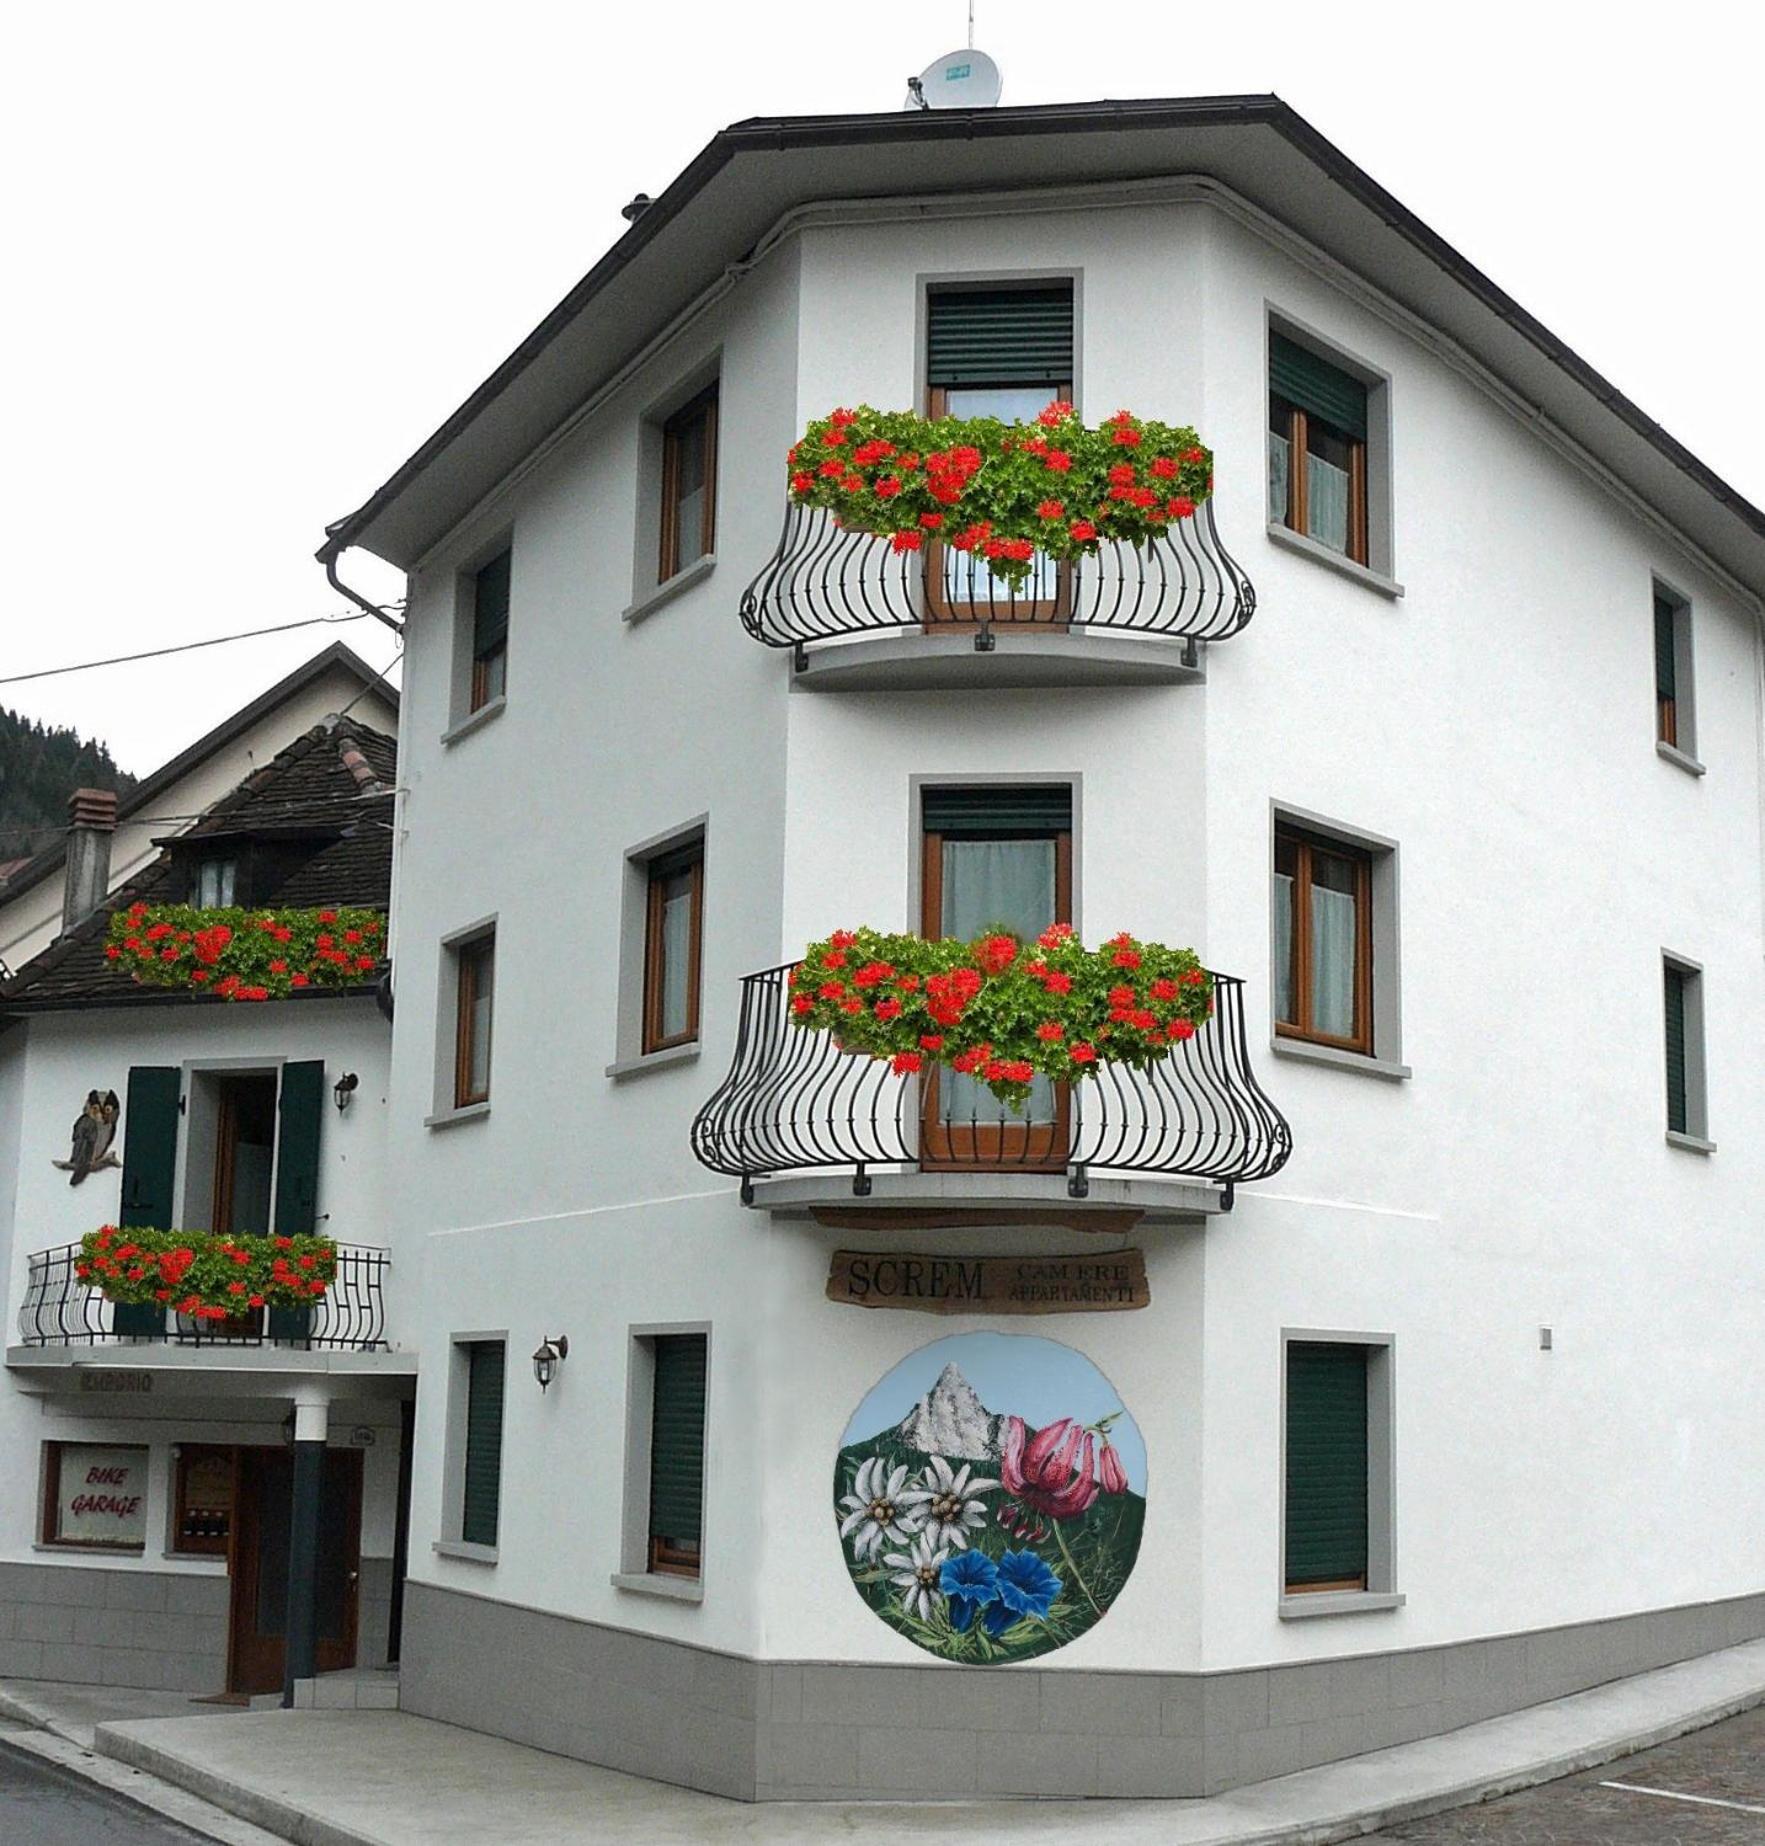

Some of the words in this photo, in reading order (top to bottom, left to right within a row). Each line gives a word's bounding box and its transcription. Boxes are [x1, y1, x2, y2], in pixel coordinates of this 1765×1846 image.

[849, 1260, 984, 1298] SCREM
[86, 1467, 128, 1484] BIKE
[71, 1494, 141, 1518] GARAGE
